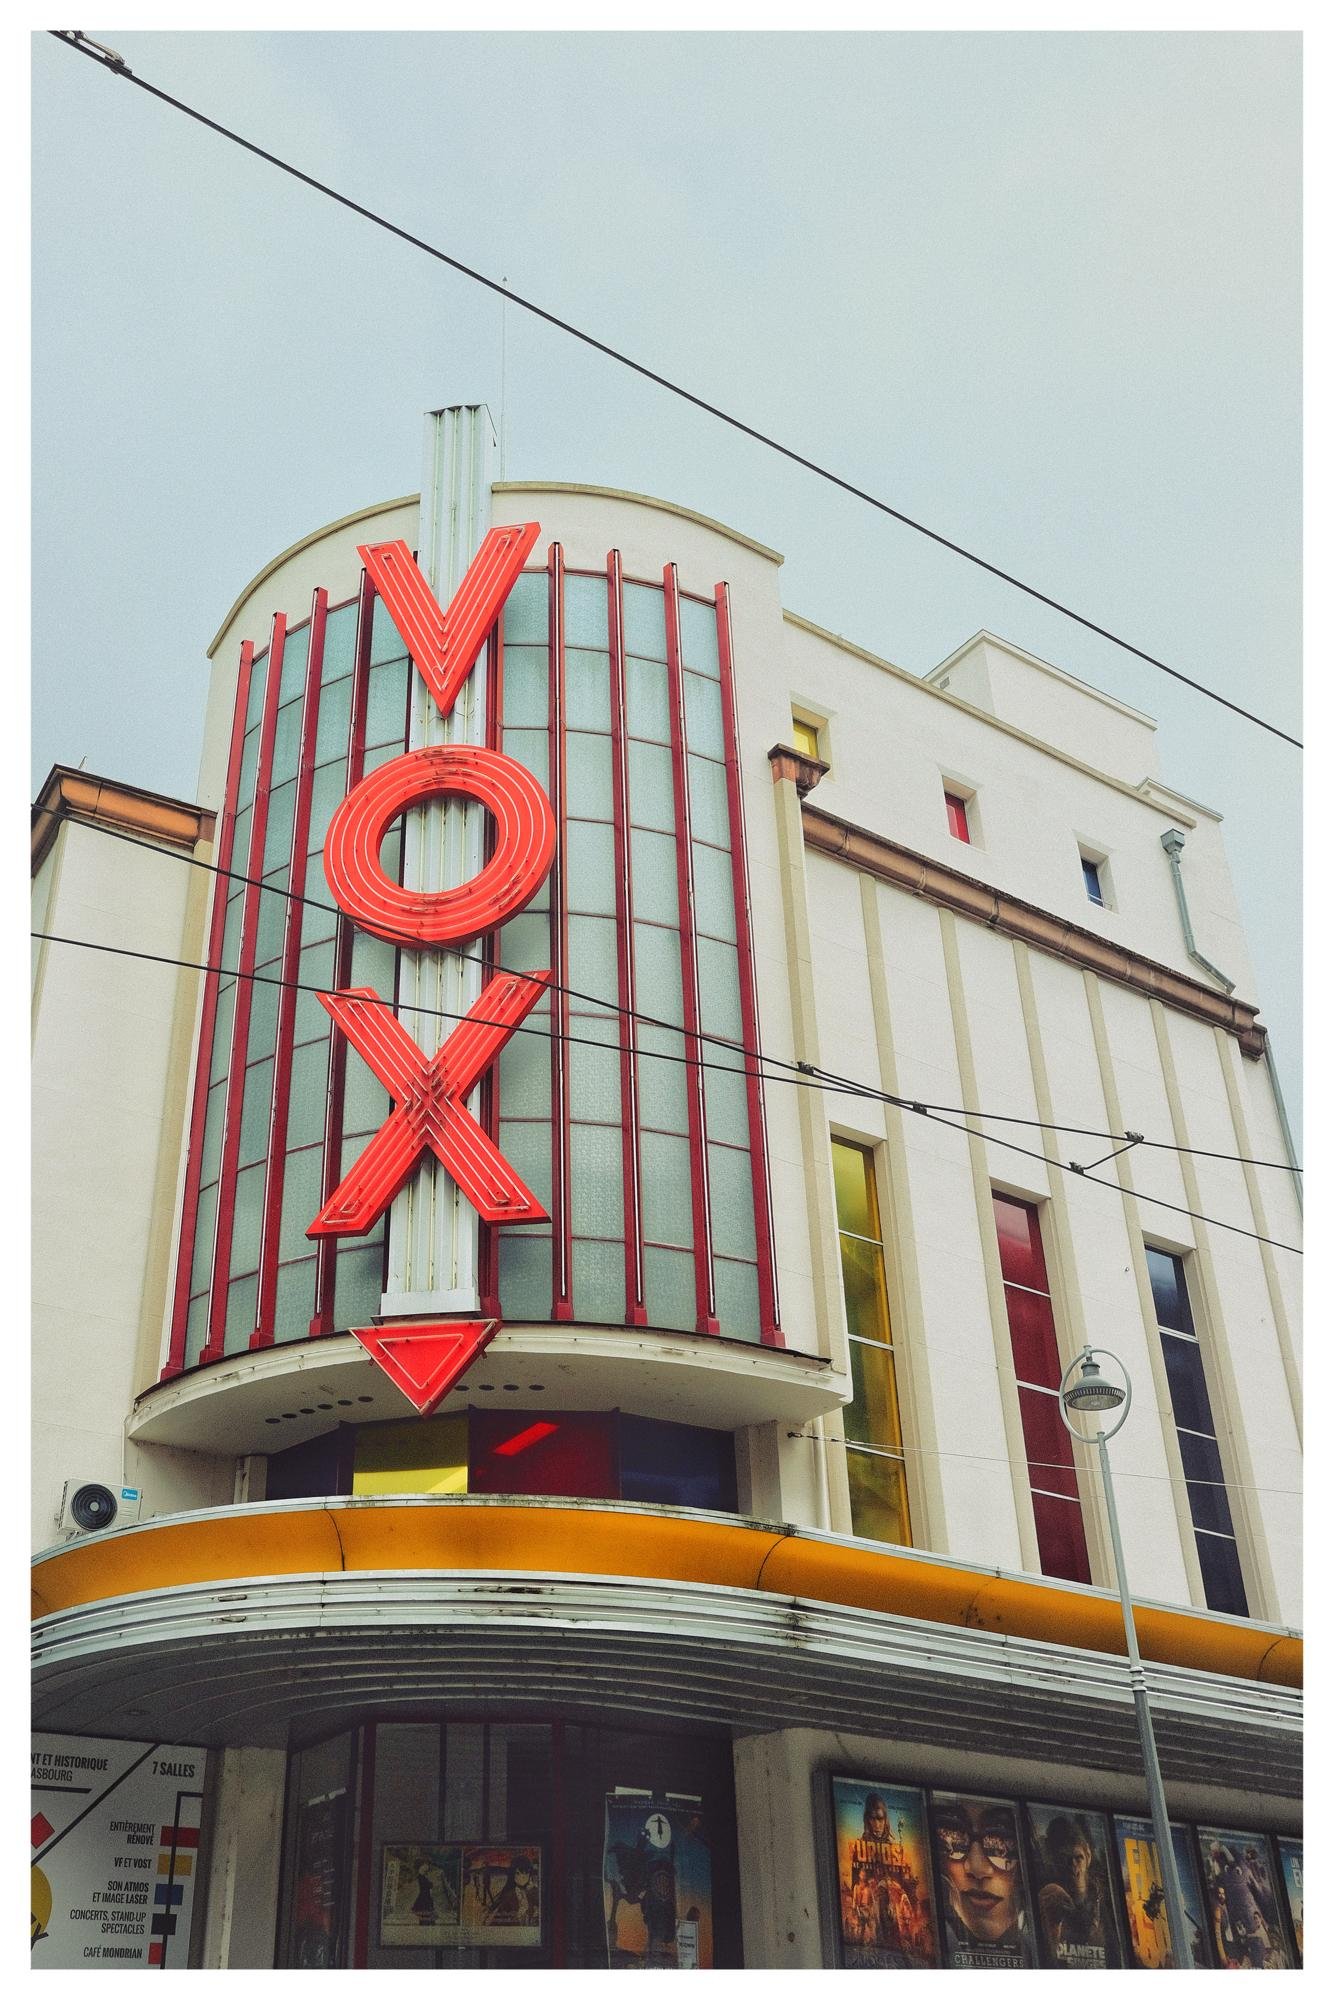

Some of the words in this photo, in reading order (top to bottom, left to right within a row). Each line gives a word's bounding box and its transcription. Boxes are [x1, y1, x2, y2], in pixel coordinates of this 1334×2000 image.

[306, 522, 556, 1239] VOX
[42, 1754, 53, 1766] ET
[54, 1755, 109, 1771] HISTORIQUE
[152, 1761, 159, 1775] 7
[160, 1762, 196, 1778] SALLES
[109, 1820, 156, 1834] ENTIÈREMENT
[114, 1857, 123, 1867] VF
[124, 1858, 132, 1868] ET
[133, 1858, 152, 1869] VOST
[107, 1880, 123, 1891] SON
[124, 1881, 150, 1892] ATMOS
[92, 1892, 101, 1903] ET
[102, 1893, 125, 1904] IMAGE
[126, 1894, 148, 1905] LASER
[111, 1910, 147, 1922] STAND-UP
[101, 1923, 145, 1935] SPECTACLES
[83, 1945, 101, 1958] CAFÉ
[102, 1947, 143, 1959] MONDRIAN
[954, 1954, 1025, 1968] CHALLENGERS
